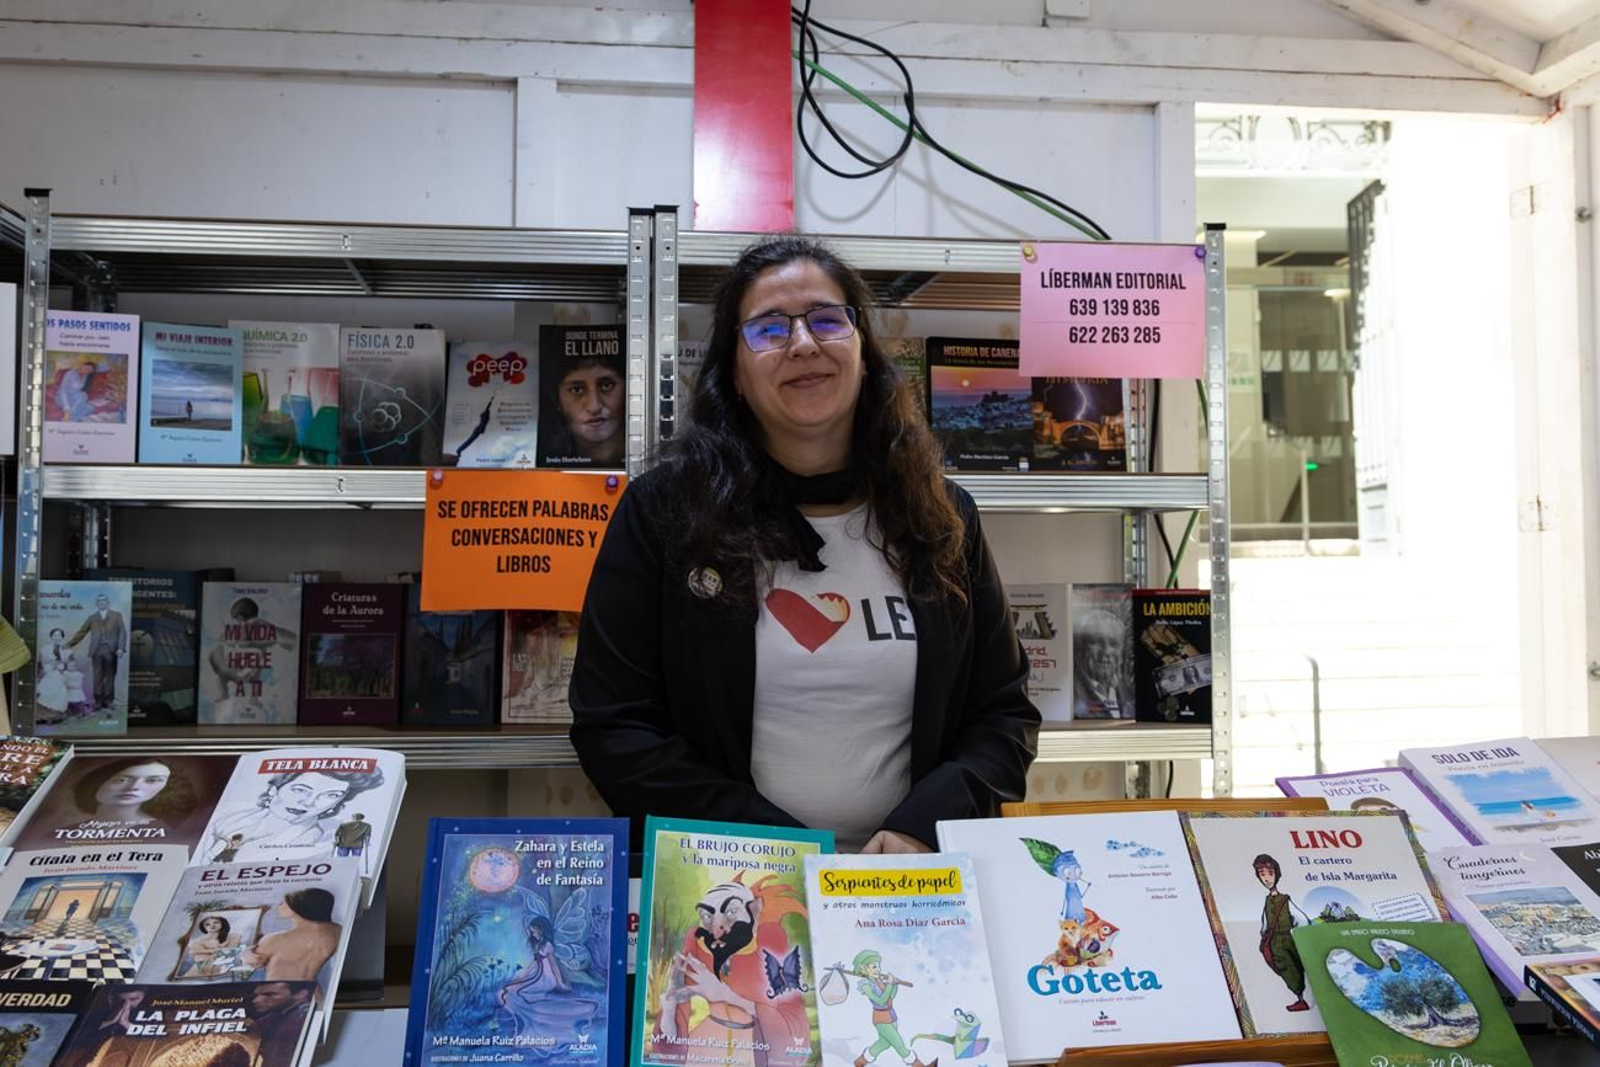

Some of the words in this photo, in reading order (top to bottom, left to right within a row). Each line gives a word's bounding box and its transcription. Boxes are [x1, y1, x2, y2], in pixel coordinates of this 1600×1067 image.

[1041, 268, 1112, 289] LÍBERMAN
[1116, 271, 1186, 290] EDITORIAL
[1069, 298, 1098, 316] 639
[1102, 298, 1129, 316] 139
[1132, 298, 1160, 316] 836
[59, 319, 87, 330] PASOS
[90, 320, 132, 332] SENTIDOS
[156, 332, 167, 341] MI
[169, 333, 192, 344] VIAJE
[195, 335, 233, 346] INTERIOR
[291, 332, 308, 342] 2.0
[347, 332, 391, 348] FÍSICA
[395, 334, 415, 349] 2.0
[565, 331, 587, 340] DONDE
[590, 331, 619, 340] TERMINA
[1069, 326, 1098, 344] 622
[1102, 326, 1130, 344] 263
[1133, 326, 1162, 344] 285
[565, 341, 579, 356] EL
[582, 341, 619, 356] LLANO
[944, 345, 978, 357] HISTORIA
[980, 346, 991, 358] DE
[992, 347, 1020, 359] CANEN
[473, 360, 523, 376] peep
[438, 500, 457, 518] SE
[461, 500, 528, 519] OFRECEN
[532, 501, 610, 521] PALABRAS
[451, 528, 585, 547] CONVERSACIONES
[588, 531, 598, 548] Y
[496, 555, 551, 573] LIBROS
[331, 591, 377, 602] Criaturas
[322, 605, 335, 615] de
[337, 605, 347, 615] la
[349, 606, 384, 616] Aurora
[1143, 602, 1157, 617] LA
[224, 624, 241, 641] MI
[246, 624, 276, 641] VIDA
[1023, 645, 1048, 657] drid,
[228, 651, 272, 669] HUELE
[236, 681, 245, 698] A
[249, 681, 262, 697] TI
[1431, 751, 1469, 766] SOLO
[1470, 748, 1492, 760] DE
[1492, 746, 1519, 758] IDA
[266, 761, 304, 771] TELA
[308, 759, 369, 771] BLANCA
[1318, 779, 1355, 787] Poesía
[1356, 776, 1380, 784] para
[1323, 783, 1390, 797] VIOLETA
[55, 827, 167, 839] TORMENTA
[1289, 829, 1363, 849] LINO
[515, 840, 556, 852] Zahara
[560, 844, 569, 856] y
[571, 839, 605, 852] Estela
[679, 838, 692, 849] EL
[696, 840, 739, 857] BRUJO
[742, 843, 797, 859] CORUJO
[30, 854, 75, 866] Cítala
[81, 853, 103, 863] en
[106, 851, 124, 862] el
[128, 850, 164, 862] Tera
[537, 859, 552, 869] en
[555, 857, 567, 868] el
[571, 856, 605, 869] Reino
[682, 855, 688, 864] y
[692, 852, 703, 866] la
[706, 856, 760, 873] mariposa
[763, 861, 797, 874] negra
[1298, 856, 1311, 866] El
[1313, 857, 1353, 866] cartero
[1443, 855, 1518, 871] Cuadernos
[200, 869, 230, 882] EL
[238, 864, 333, 880] ESPEJO
[537, 873, 552, 886] de
[555, 872, 604, 886] Fantasía
[1305, 871, 1318, 882] de
[1320, 871, 1341, 881] Isla
[1343, 871, 1398, 882] Margarita
[822, 871, 897, 895] Serpientes
[897, 874, 914, 890] de
[916, 870, 956, 894] papel
[823, 901, 830, 911] y
[832, 901, 857, 909] otros
[860, 899, 908, 910] monstruos
[911, 897, 966, 909] horricómicos
[854, 918, 875, 929] Ana
[877, 918, 903, 929] Rosa
[904, 916, 929, 928] Díaz
[930, 915, 966, 927] García
[1026, 964, 1163, 997] Goteta
[0, 992, 72, 1007] VERDAD
[151, 999, 173, 1007] José
[174, 998, 212, 1006] Manuel
[212, 996, 244, 1005] Muriel
[135, 1010, 165, 1023] LA
[174, 1007, 247, 1021] PLAGA
[126, 1023, 168, 1036] DEL
[177, 1020, 248, 1036] INFIEL
[432, 1036, 447, 1047] Mª
[449, 1035, 491, 1047] Manuela
[492, 1035, 515, 1046] Ruiz
[515, 1035, 557, 1046] Palacios
[569, 1043, 598, 1052] ALADIA
[650, 1034, 666, 1044] Mª
[666, 1034, 708, 1047] Manuela
[708, 1036, 731, 1049] Ruiz
[731, 1039, 771, 1052] Palacios
[469, 1053, 494, 1063] Juana
[495, 1052, 525, 1063] Carrillo
[785, 1046, 813, 1055] ALADIA
